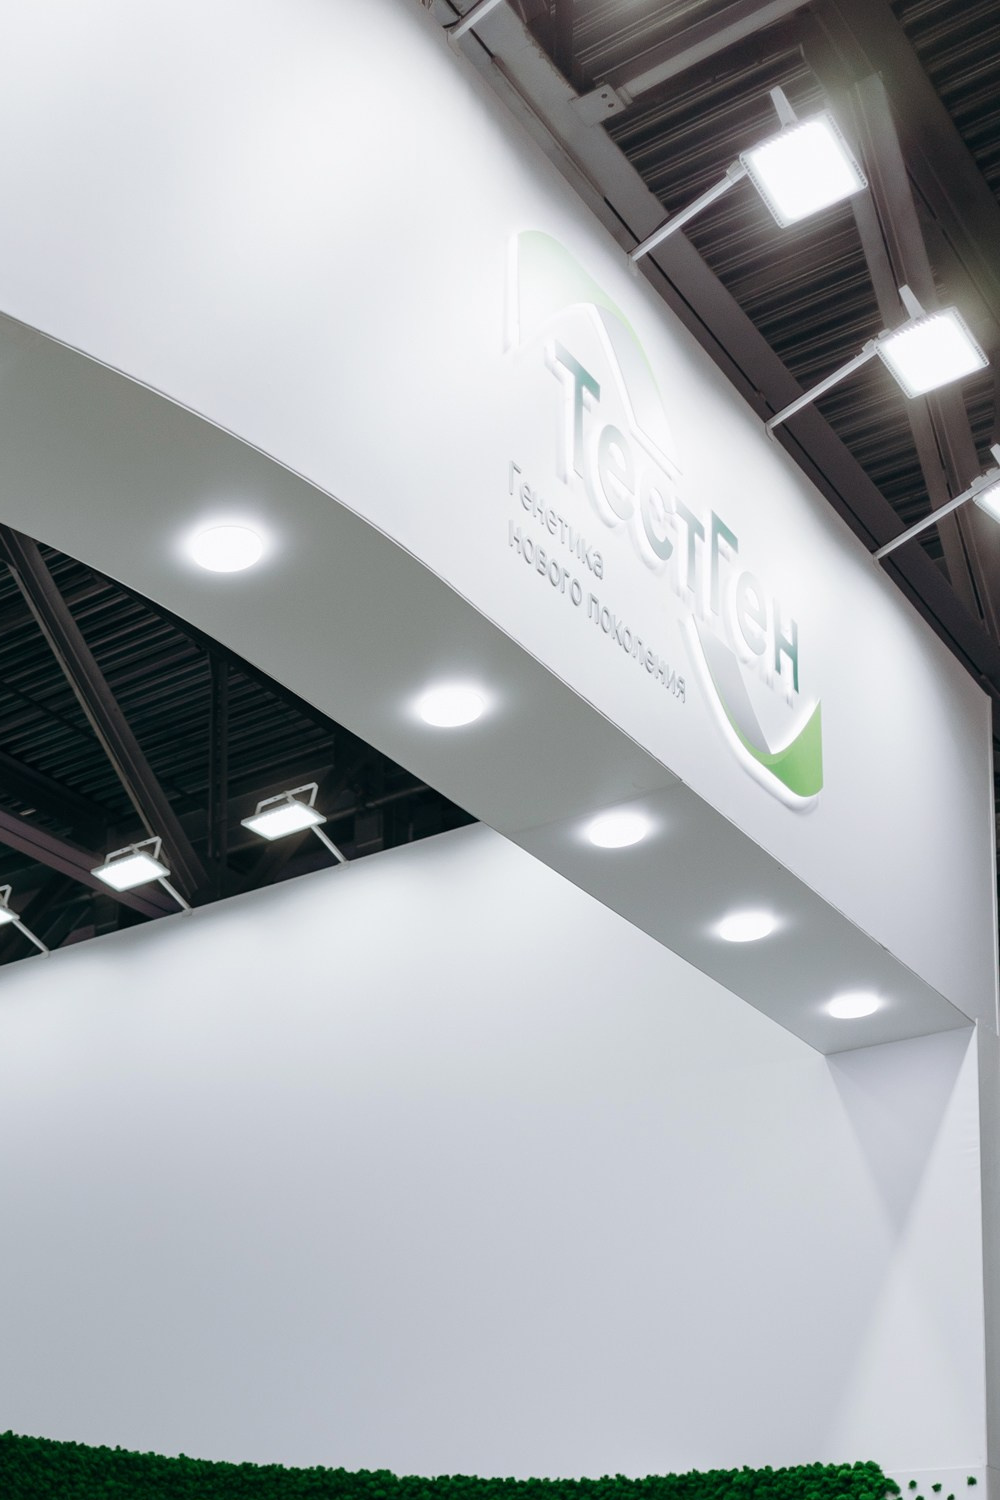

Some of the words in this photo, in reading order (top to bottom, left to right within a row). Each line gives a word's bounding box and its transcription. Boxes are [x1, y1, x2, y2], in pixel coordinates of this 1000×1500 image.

[508, 460, 604, 580] Генетика
[508, 519, 582, 606] нового
[588, 593, 686, 703] поколения
[548, 340, 799, 700] ТестГен
